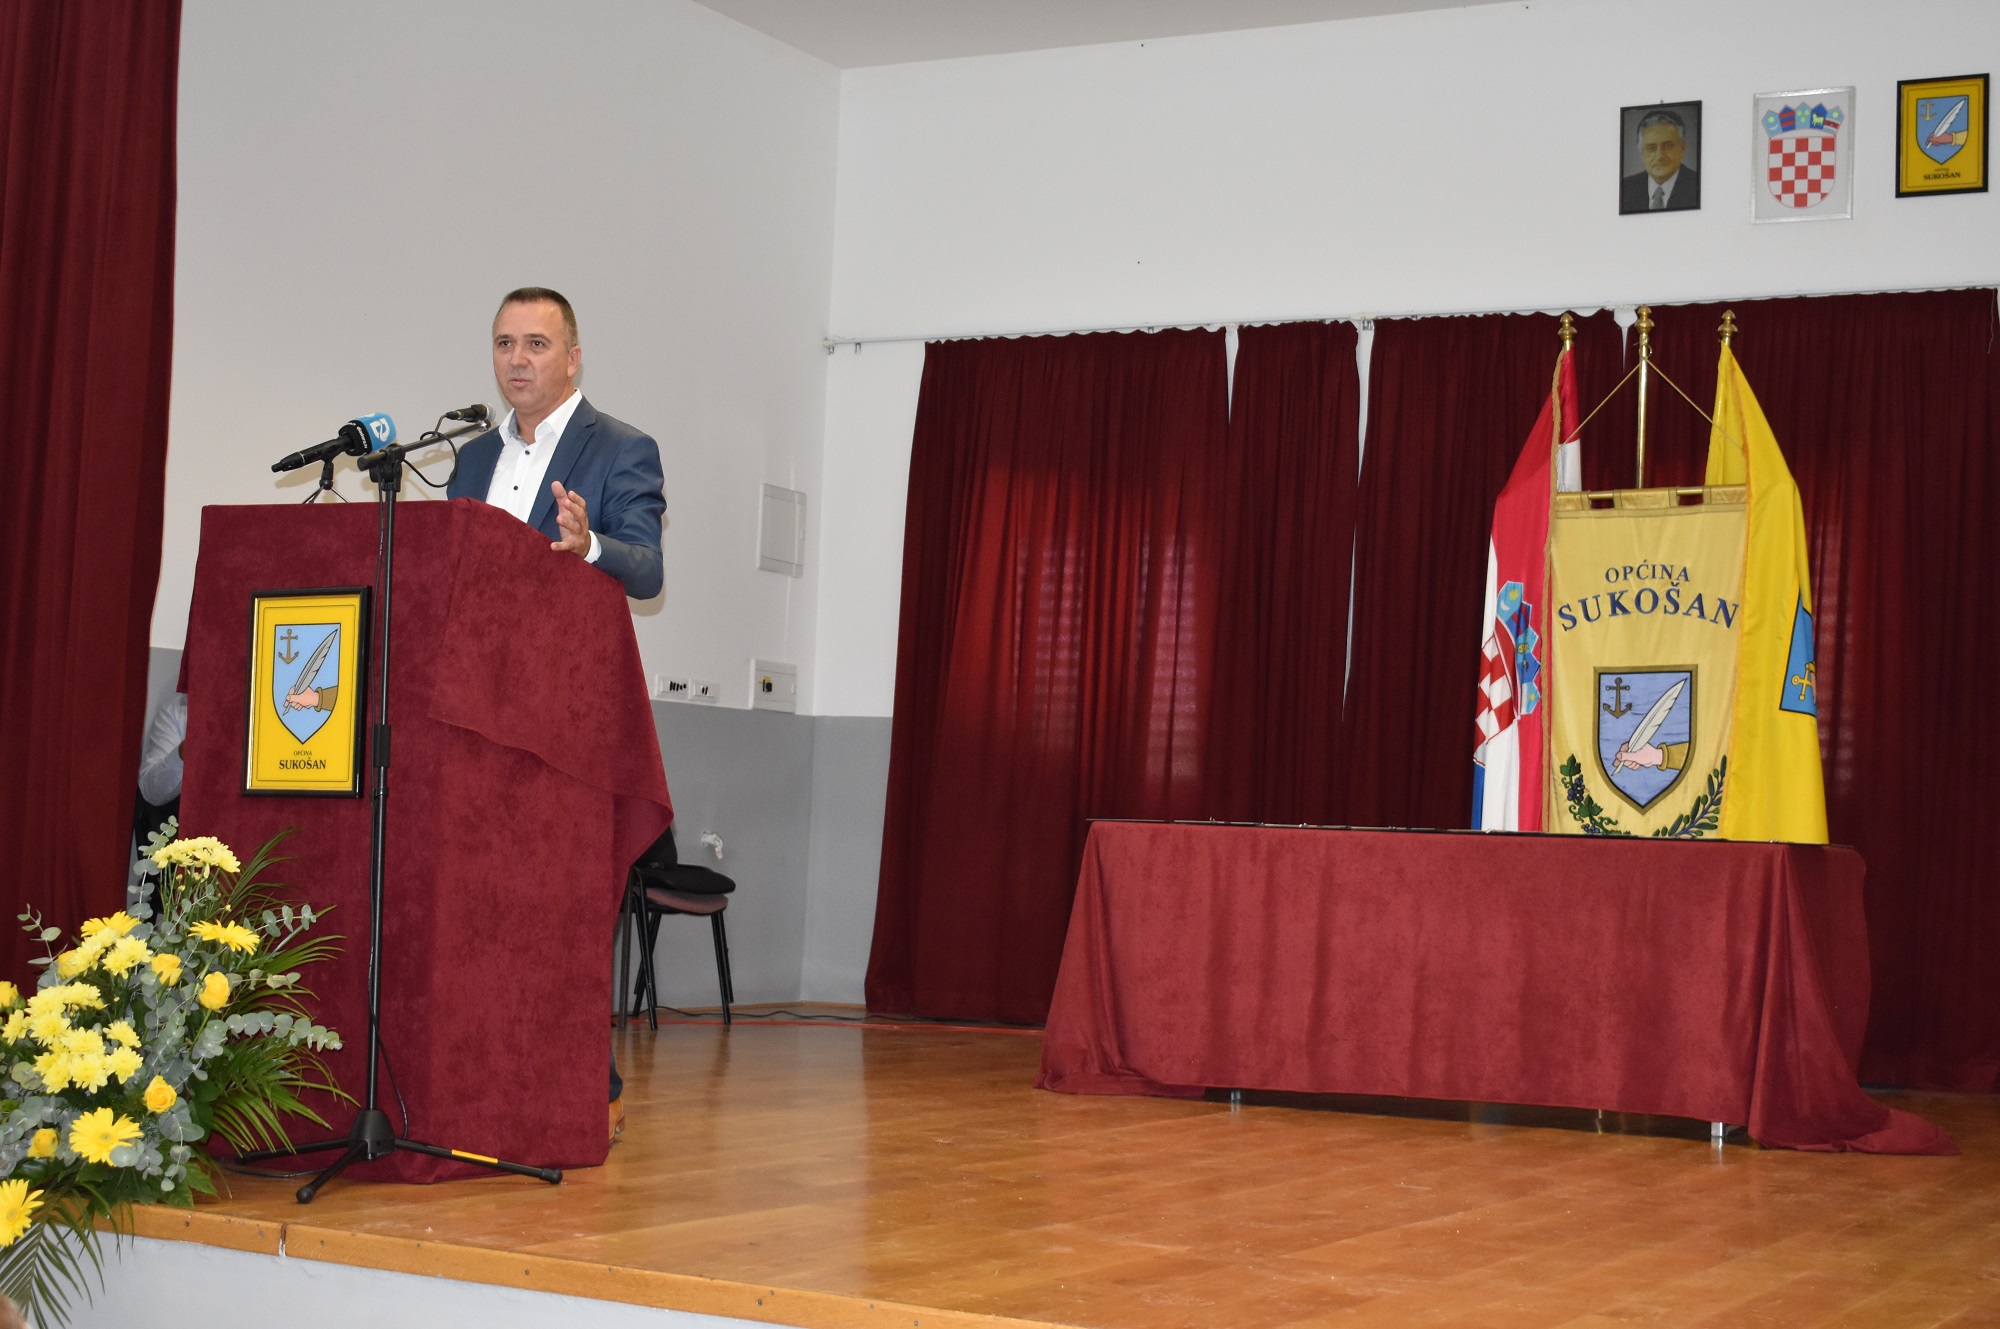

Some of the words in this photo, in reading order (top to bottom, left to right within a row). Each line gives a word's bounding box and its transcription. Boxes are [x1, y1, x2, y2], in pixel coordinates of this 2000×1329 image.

[1605, 559, 1690, 583] OPĆINA
[1558, 581, 1739, 632] SUKOŠAN
[278, 757, 327, 770] SUKOŠAN
